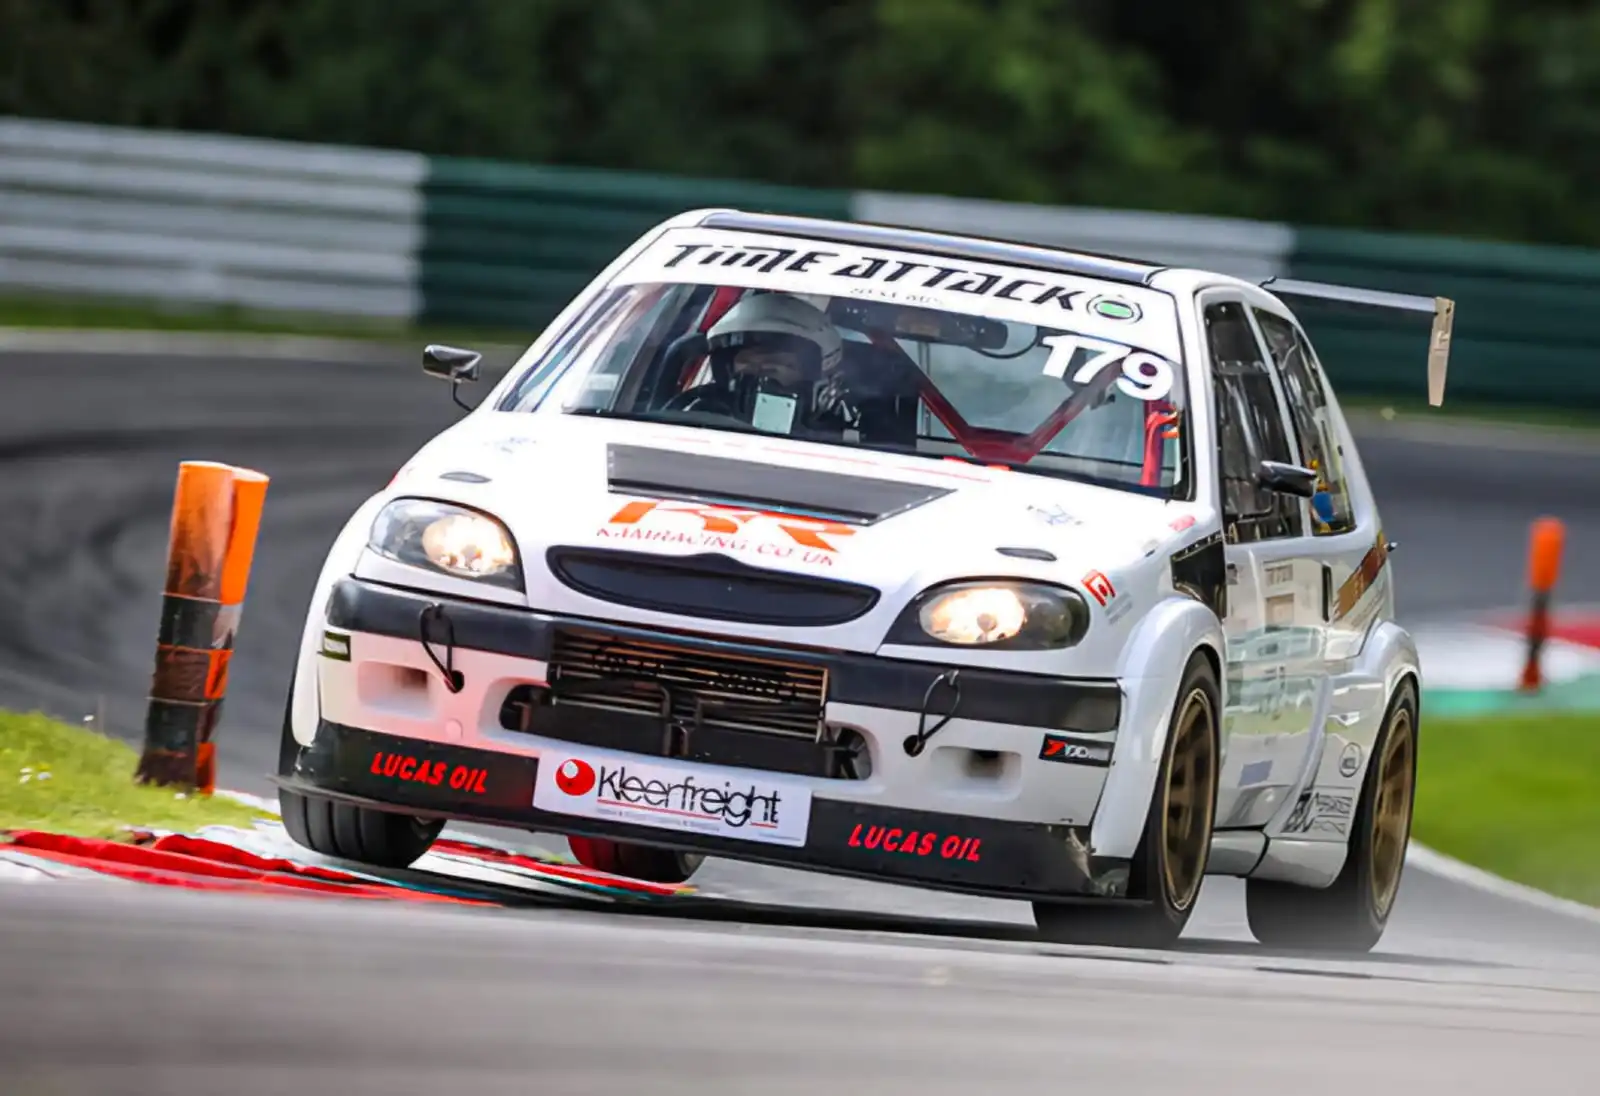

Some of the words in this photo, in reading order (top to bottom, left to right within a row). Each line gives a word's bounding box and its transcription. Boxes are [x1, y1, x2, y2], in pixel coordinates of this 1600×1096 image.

[1042, 335, 1174, 400] 179
[370, 752, 447, 785] LUCAS
[449, 765, 488, 794] OIL
[598, 766, 782, 828] Kleerfreight
[848, 823, 937, 856] LUCAS
[940, 835, 982, 863] OIL
